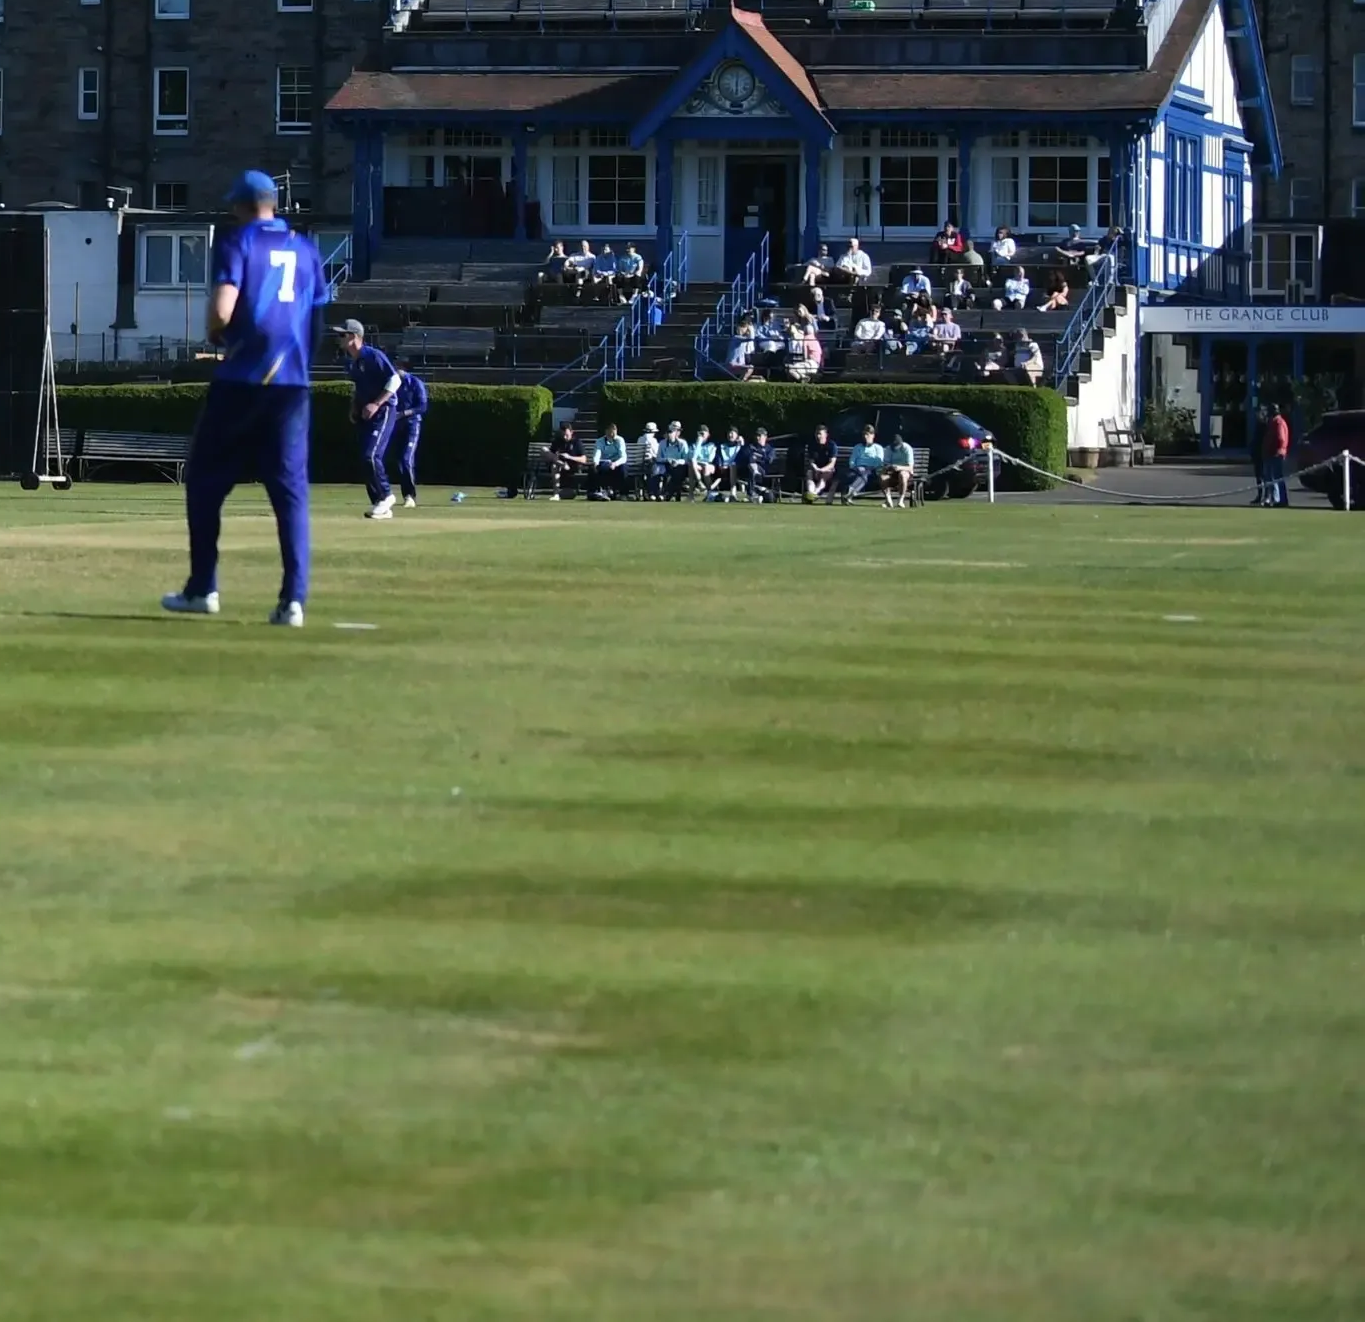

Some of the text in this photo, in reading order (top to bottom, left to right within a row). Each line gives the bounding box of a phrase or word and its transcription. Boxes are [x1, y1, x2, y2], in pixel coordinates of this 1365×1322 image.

[270, 250, 296, 302] 7
[1185, 309, 1329, 322] THE GRANGE CLUB
